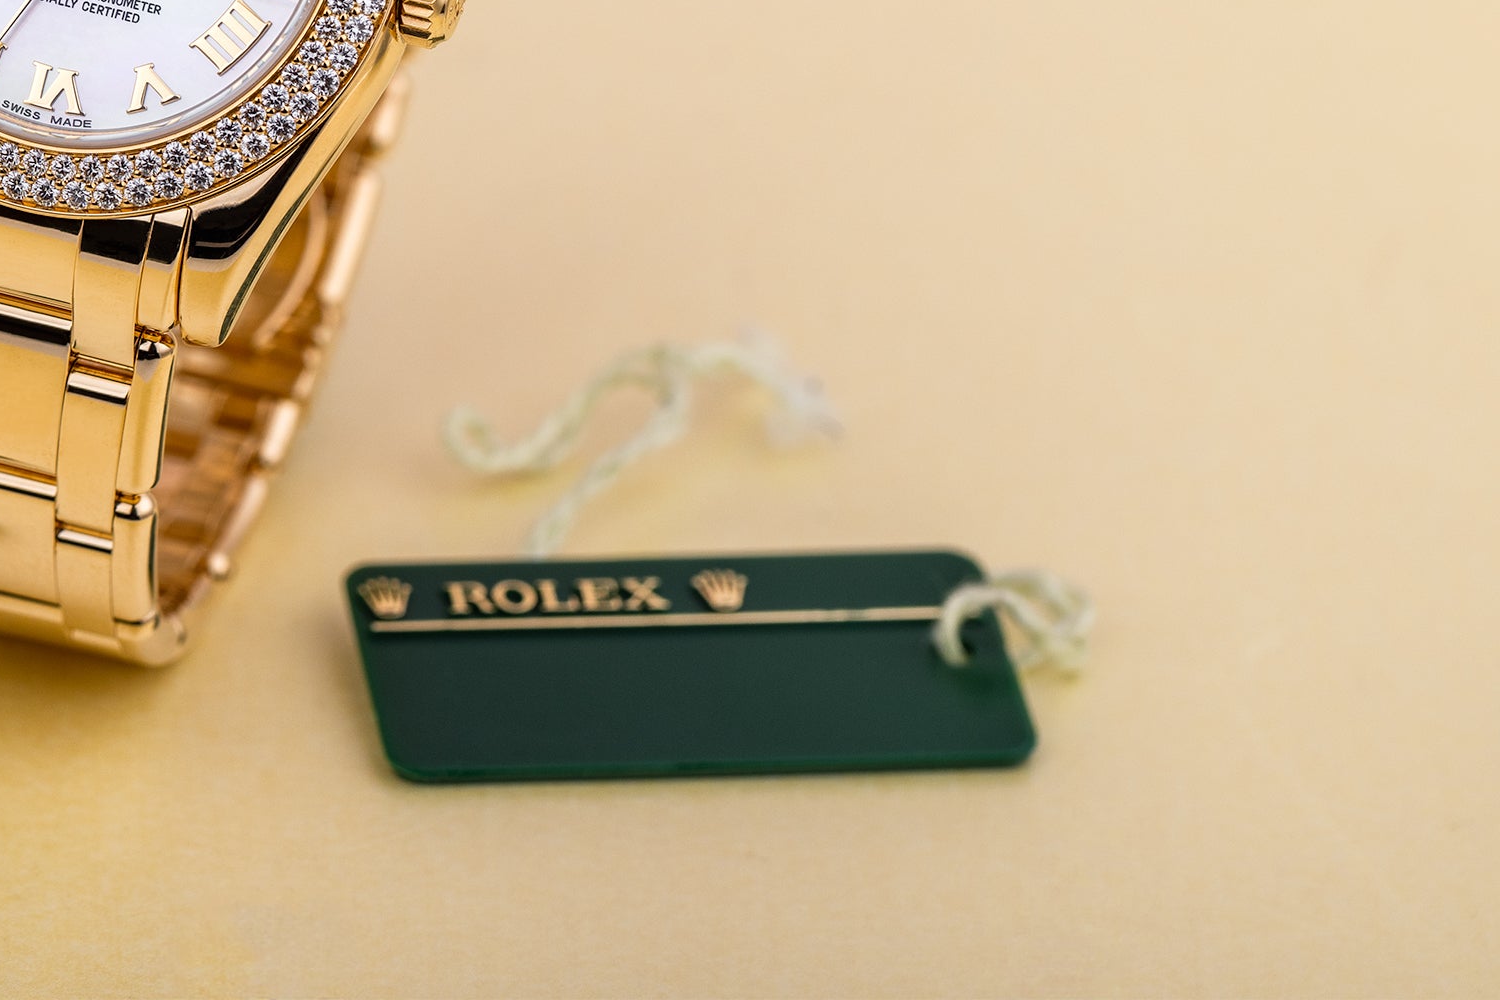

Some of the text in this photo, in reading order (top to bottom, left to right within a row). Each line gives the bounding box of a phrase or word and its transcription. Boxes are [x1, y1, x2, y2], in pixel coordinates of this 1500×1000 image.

[81, 1, 141, 24] CERTIFIED
[126, 63, 181, 115] V
[1, 99, 93, 128] SWISS MADE
[444, 575, 672, 616] ROLEX
